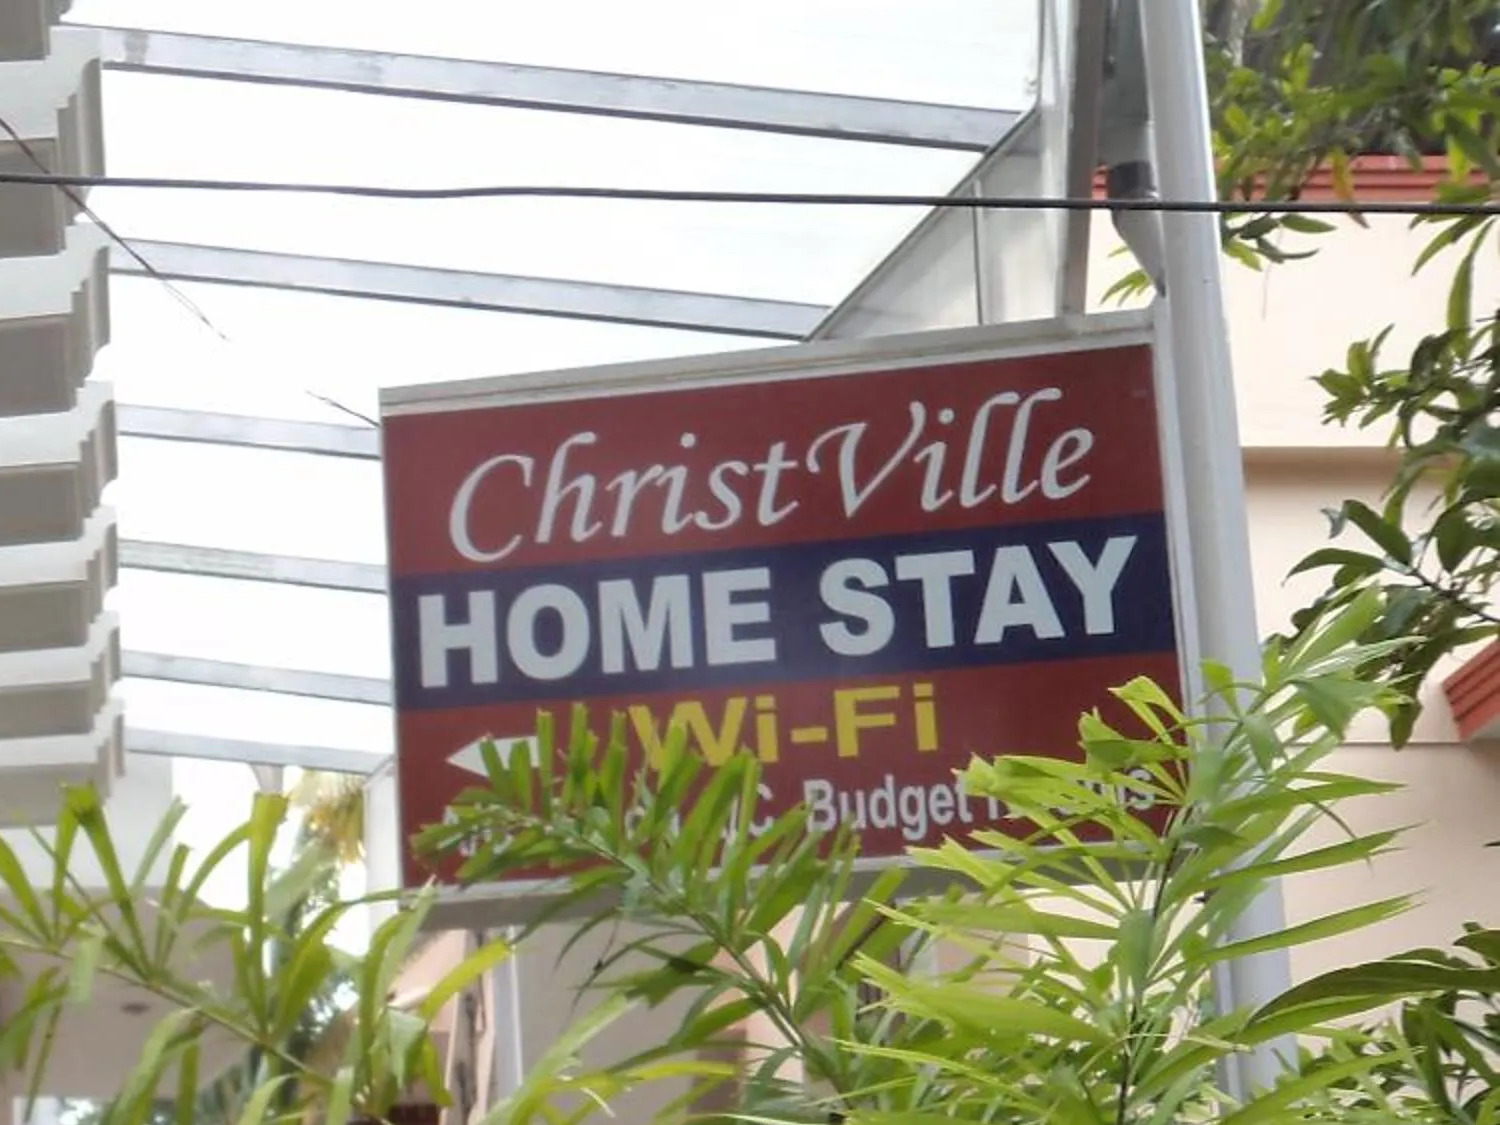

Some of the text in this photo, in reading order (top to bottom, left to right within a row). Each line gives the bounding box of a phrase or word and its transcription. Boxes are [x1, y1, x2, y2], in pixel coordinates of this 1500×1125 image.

[417, 535, 1139, 690] HOME STAY
[627, 682, 940, 772] Wi-Fi
[803, 767, 974, 841] Budget
